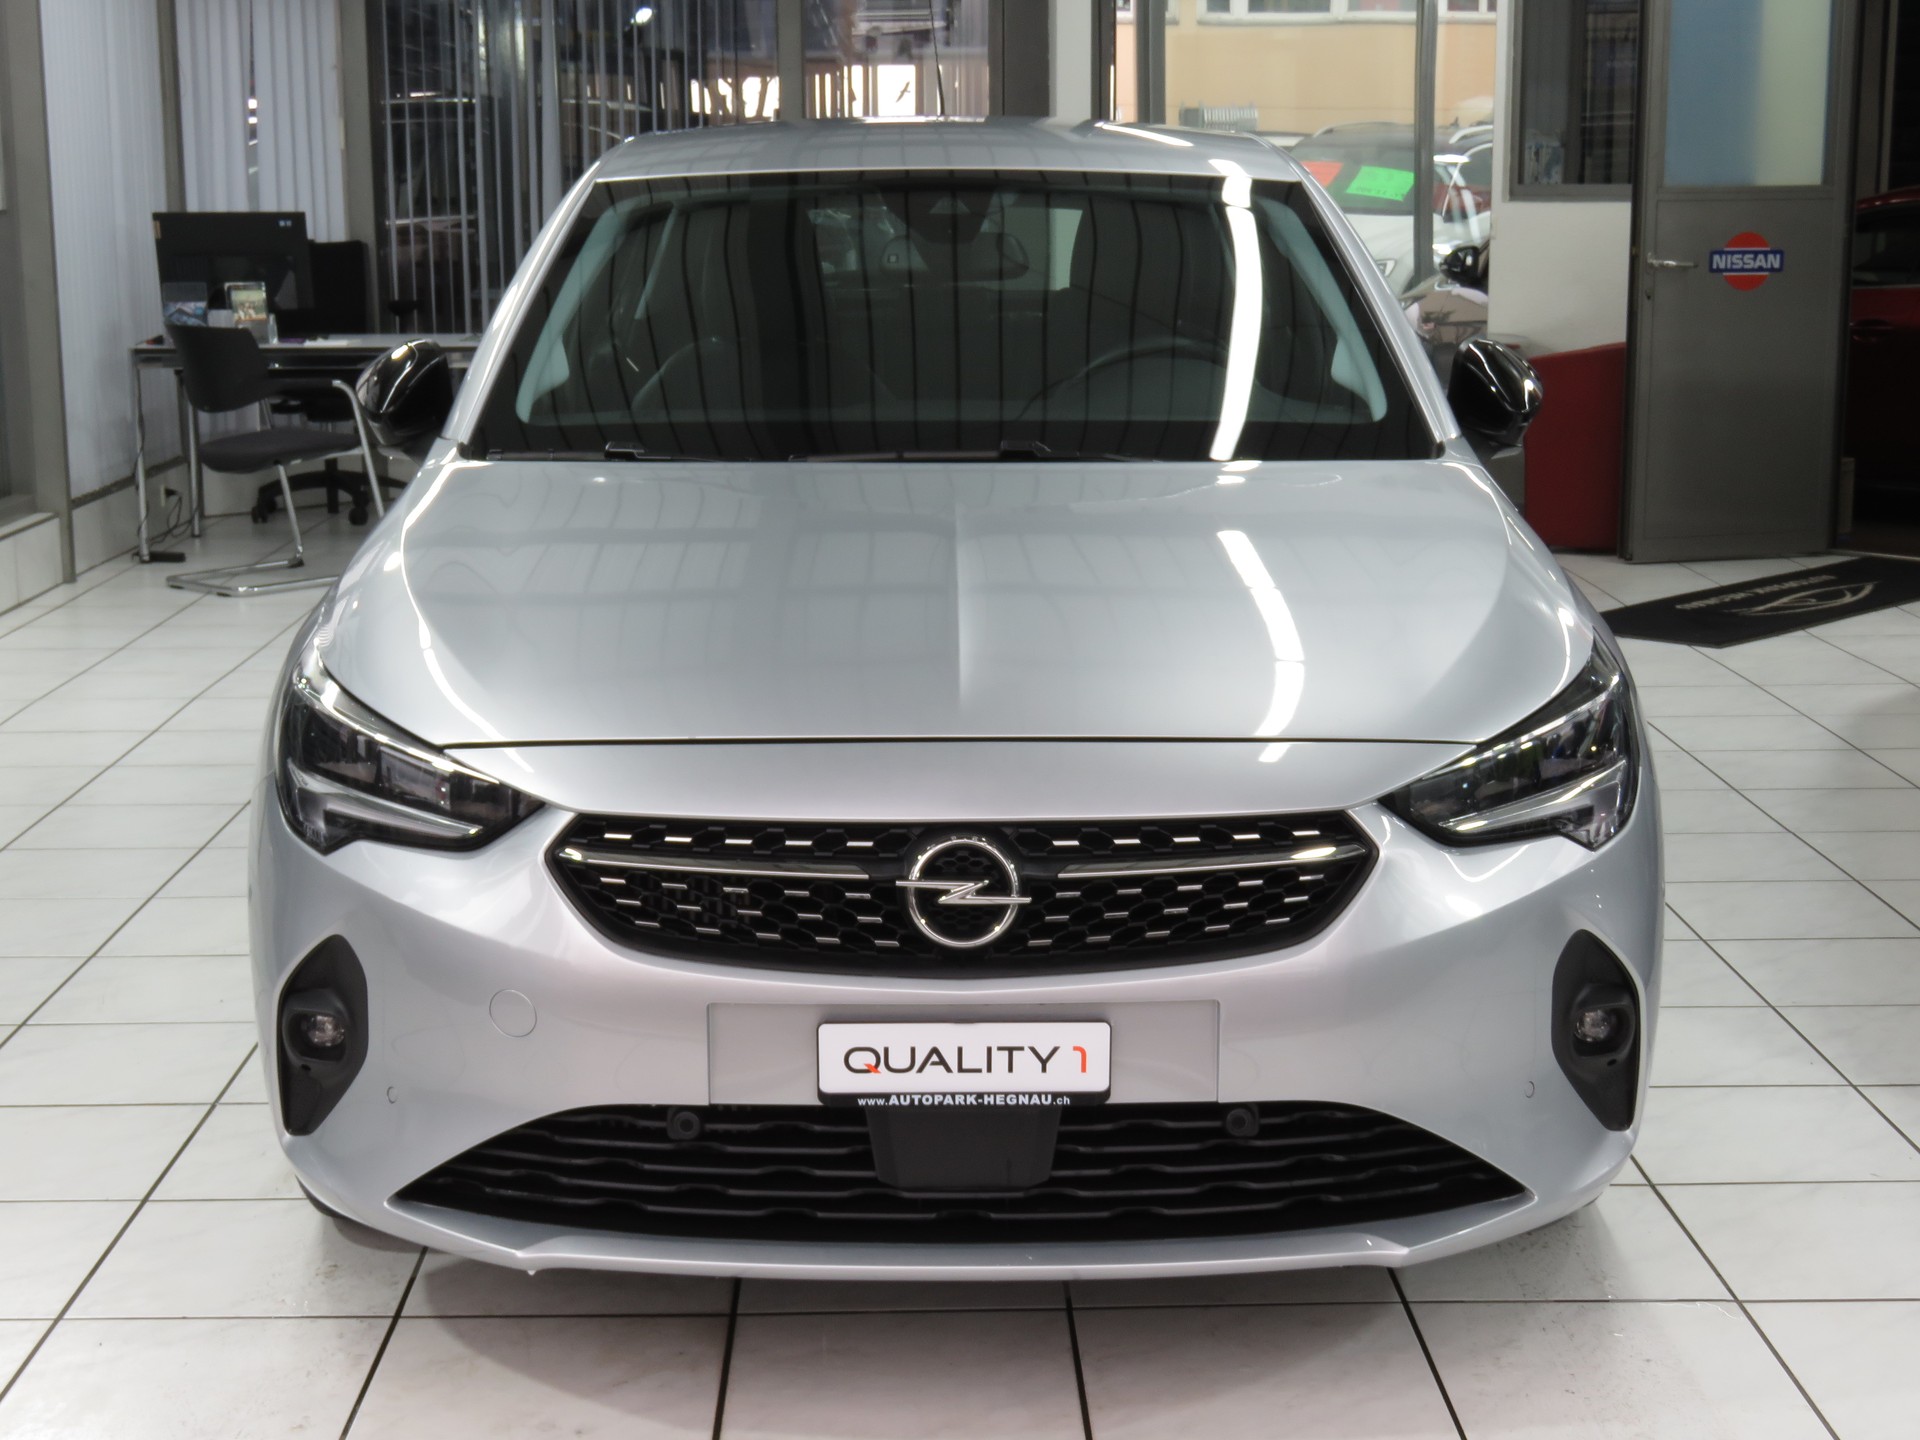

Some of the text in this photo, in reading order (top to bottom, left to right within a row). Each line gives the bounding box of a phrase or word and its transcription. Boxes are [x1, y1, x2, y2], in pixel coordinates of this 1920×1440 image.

[1712, 253, 1781, 269] NISSAN
[843, 1045, 1087, 1074] QUALITY 1
[857, 1094, 1070, 1106] www.AUTOPARK-HEGNAU.ch
